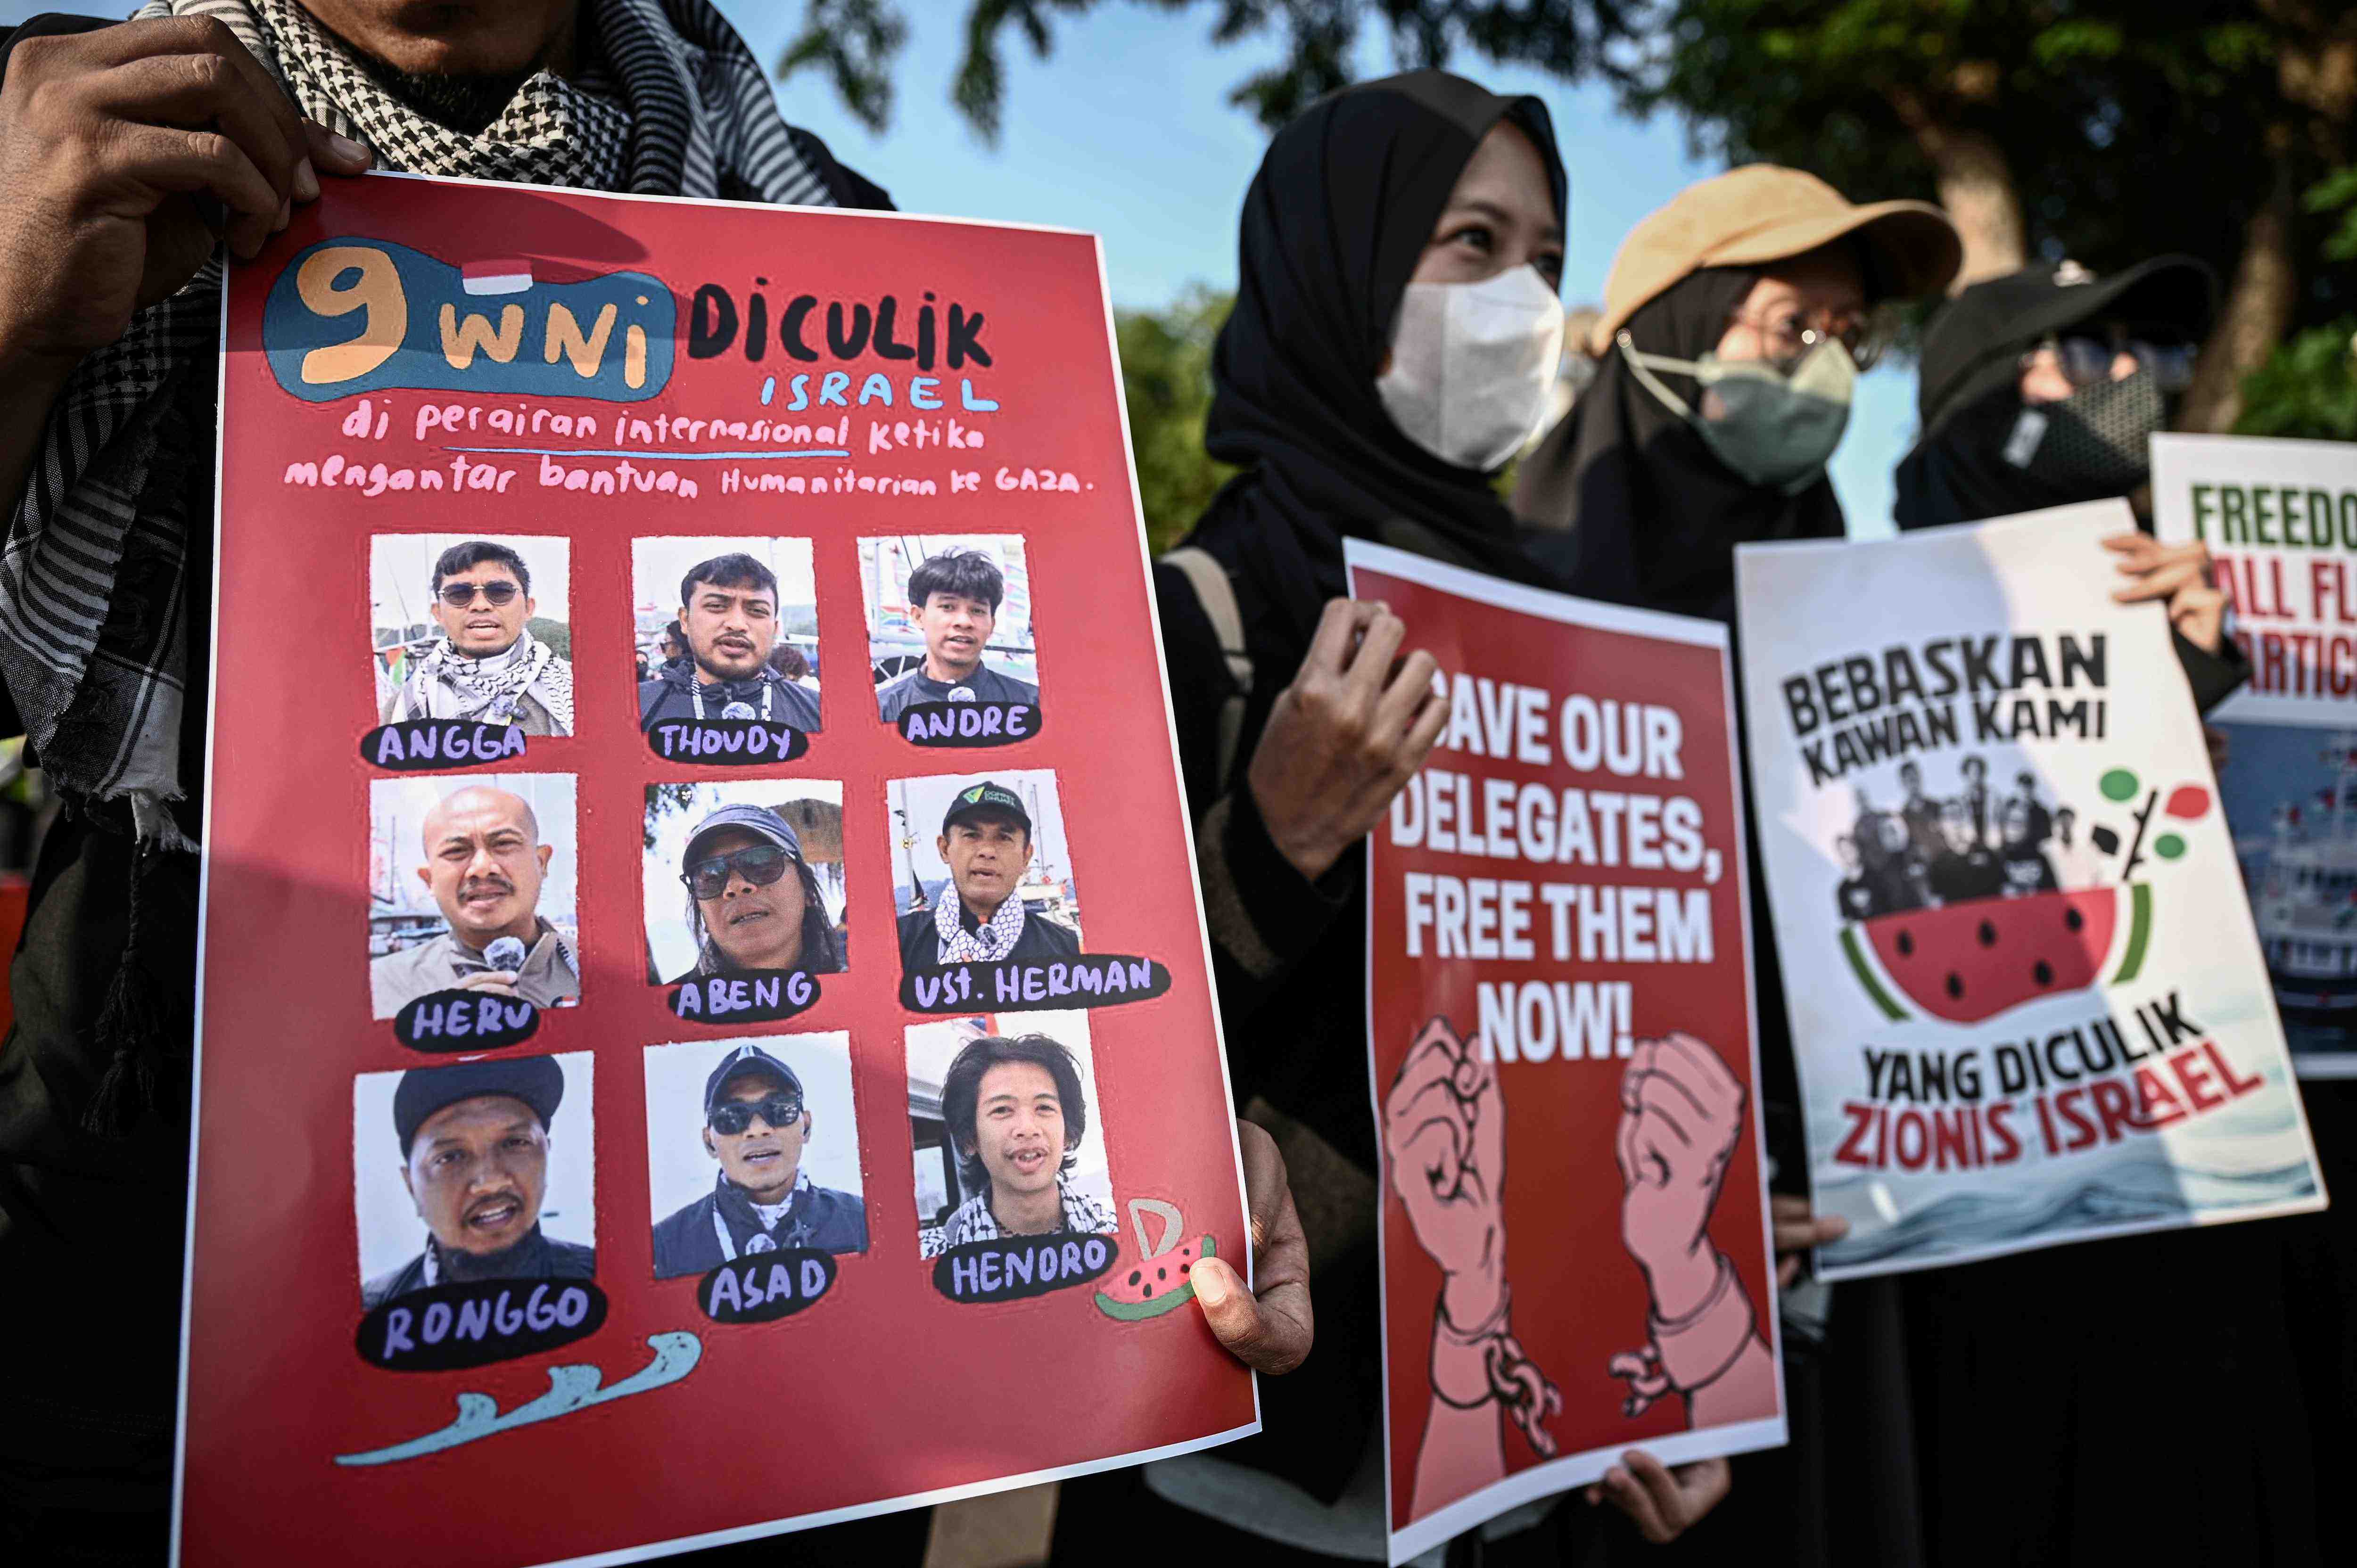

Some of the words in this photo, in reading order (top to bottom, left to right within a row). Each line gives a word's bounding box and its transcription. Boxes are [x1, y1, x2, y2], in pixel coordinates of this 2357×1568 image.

[297, 248, 407, 384] 9
[341, 399, 392, 440] di
[415, 403, 597, 441] perairan
[615, 410, 849, 446] internasional
[761, 371, 999, 411] ISRAEL
[283, 454, 517, 497] mengantar
[539, 454, 698, 499] bantuan
[1781, 632, 2108, 737] BEBASKAN
[2233, 630, 2357, 698] ARTIC
[377, 723, 527, 764] ANGGA
[907, 705, 1030, 741] ANDRE
[1559, 693, 1684, 780] OUR
[1800, 701, 1961, 788] KAWAN
[1973, 698, 2108, 743] KAMI
[1389, 767, 1723, 884] DELEGATES,
[1403, 872, 1535, 961] FREE
[1541, 881, 1714, 964] THEM
[676, 971, 812, 1017] ABENG
[995, 957, 1152, 1004] HERMAN
[1476, 979, 1635, 1064] NOW!
[1863, 1045, 1982, 1104] YANG
[1994, 989, 2204, 1094] DICULIK
[1832, 1099, 2023, 1174] ZIONIS
[2036, 1039, 2265, 1157] ISRAEL
[709, 1259, 827, 1318] ASAD
[952, 1239, 1107, 1296] HENDRO
[382, 1282, 590, 1360] RONGGO
